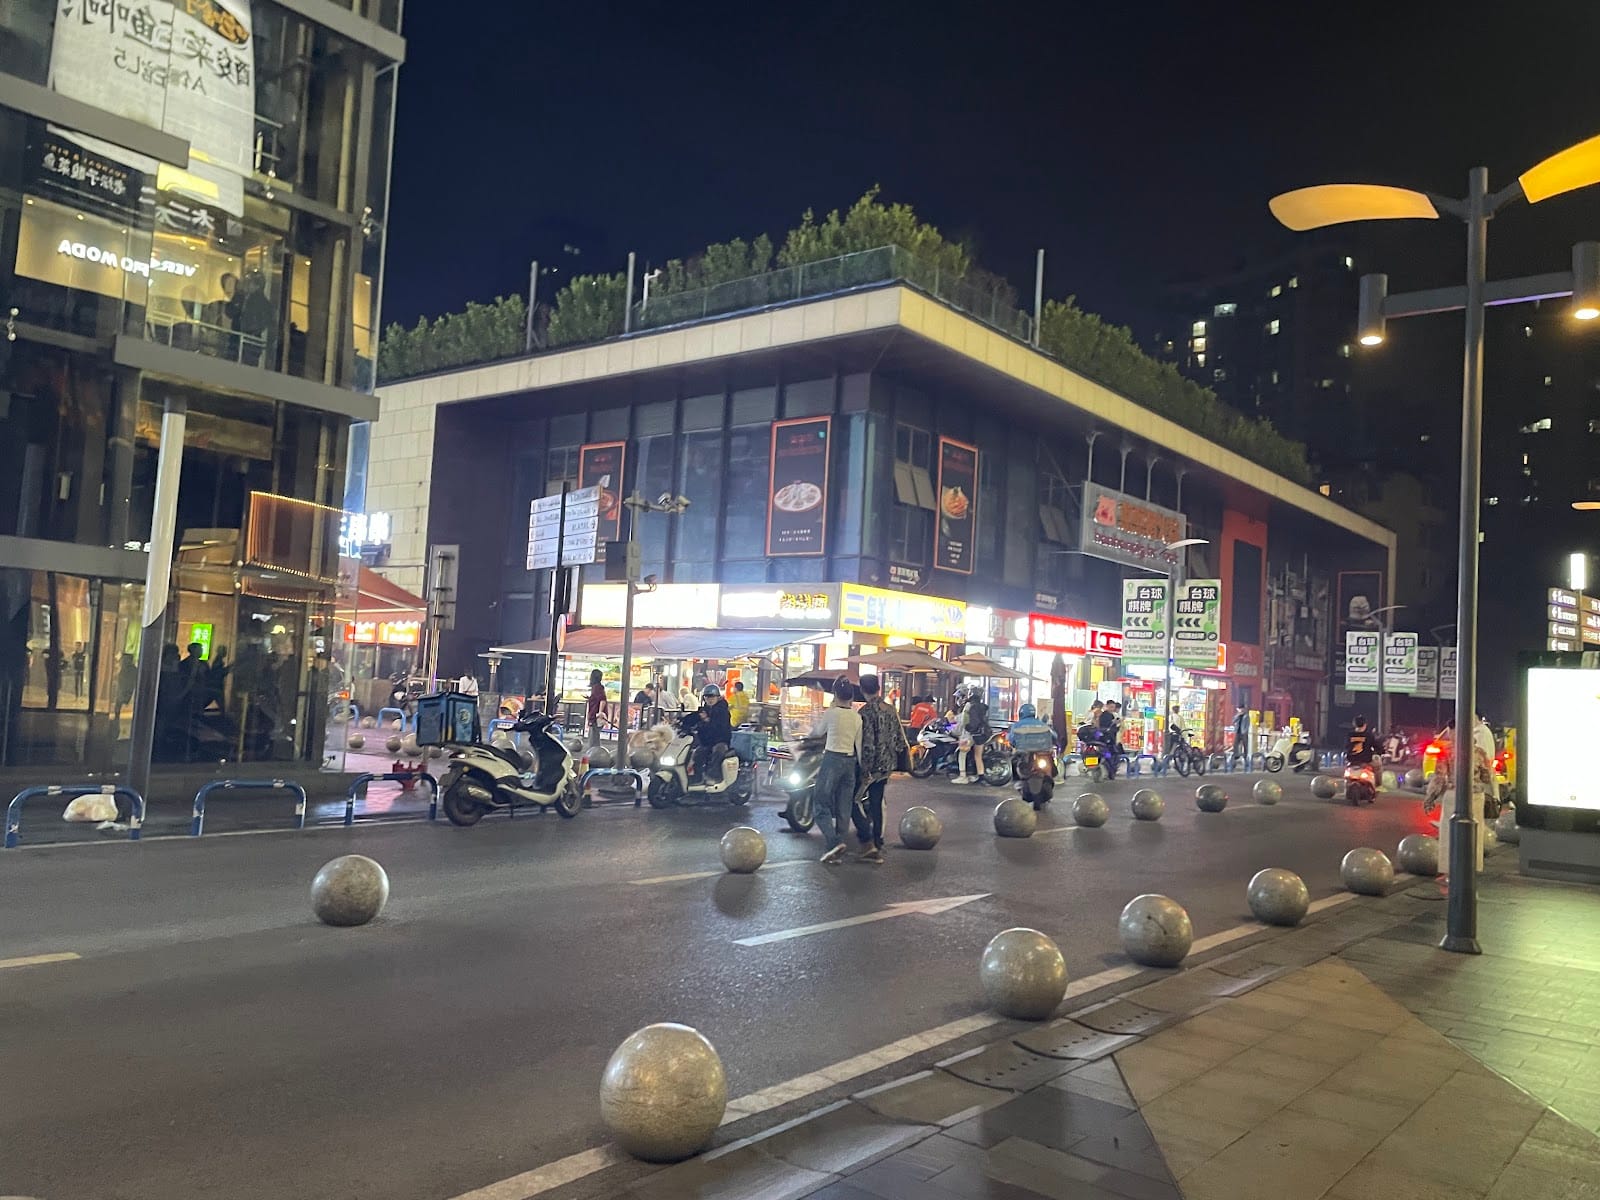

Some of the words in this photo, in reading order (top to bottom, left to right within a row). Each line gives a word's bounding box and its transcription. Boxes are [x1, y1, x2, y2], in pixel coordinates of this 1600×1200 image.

[1139, 587, 1163, 599] 台球
[1190, 588, 1216, 599] 台球
[1127, 601, 1152, 613] 棋牌
[1178, 601, 1204, 613] 棋牌
